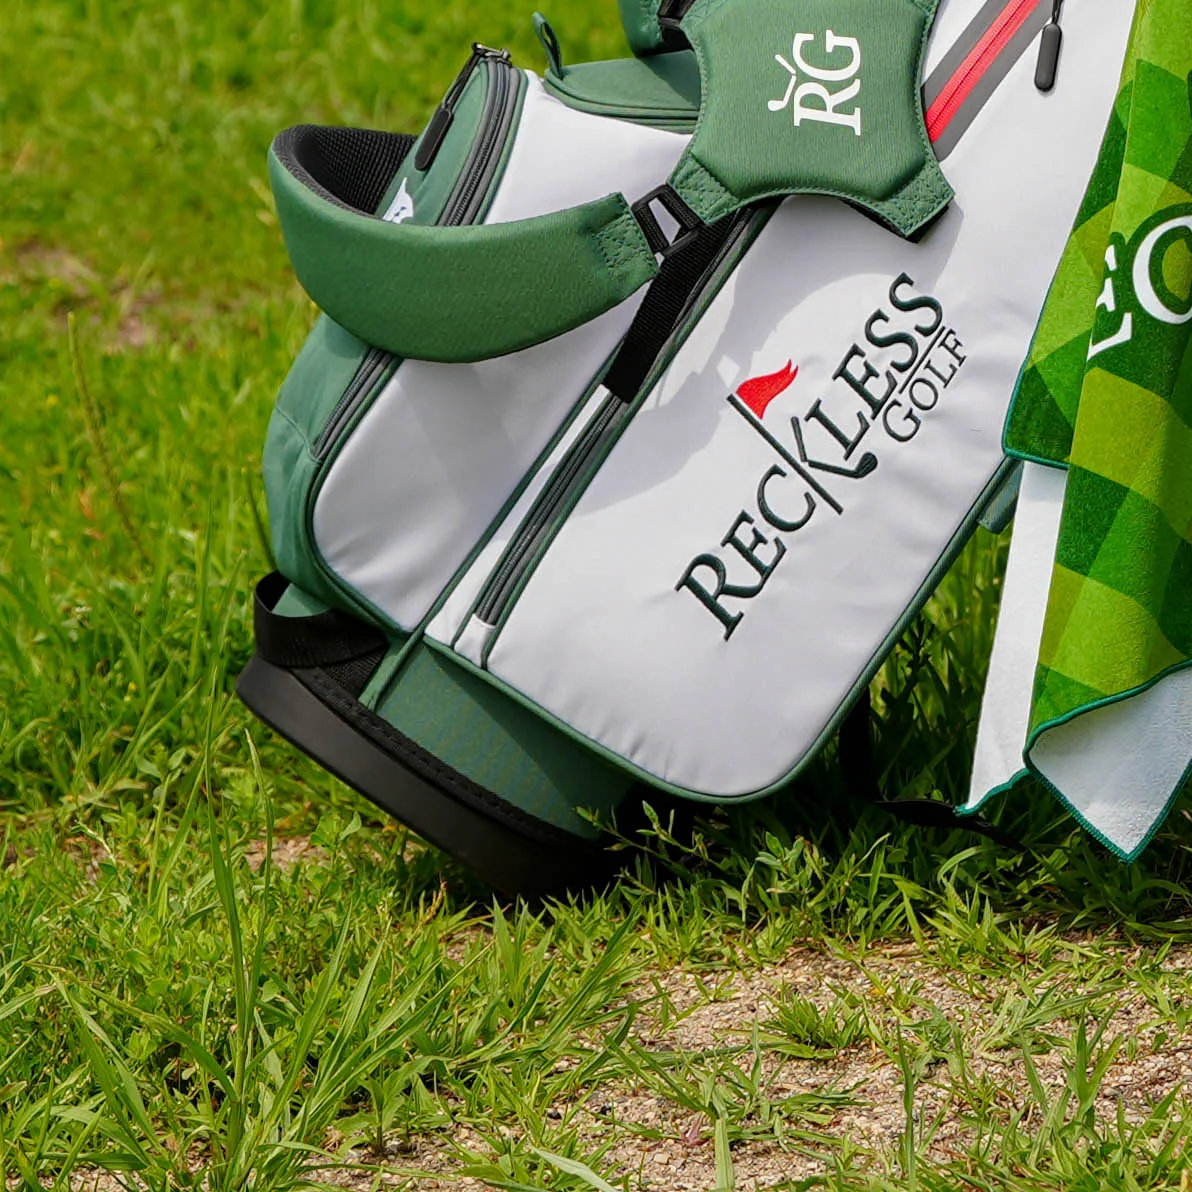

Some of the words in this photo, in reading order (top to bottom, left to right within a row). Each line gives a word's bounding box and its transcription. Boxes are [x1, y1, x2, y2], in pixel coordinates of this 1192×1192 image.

[792, 29, 861, 136] RG
[882, 328, 968, 443] GOLF
[674, 272, 944, 642] RECKLESS
